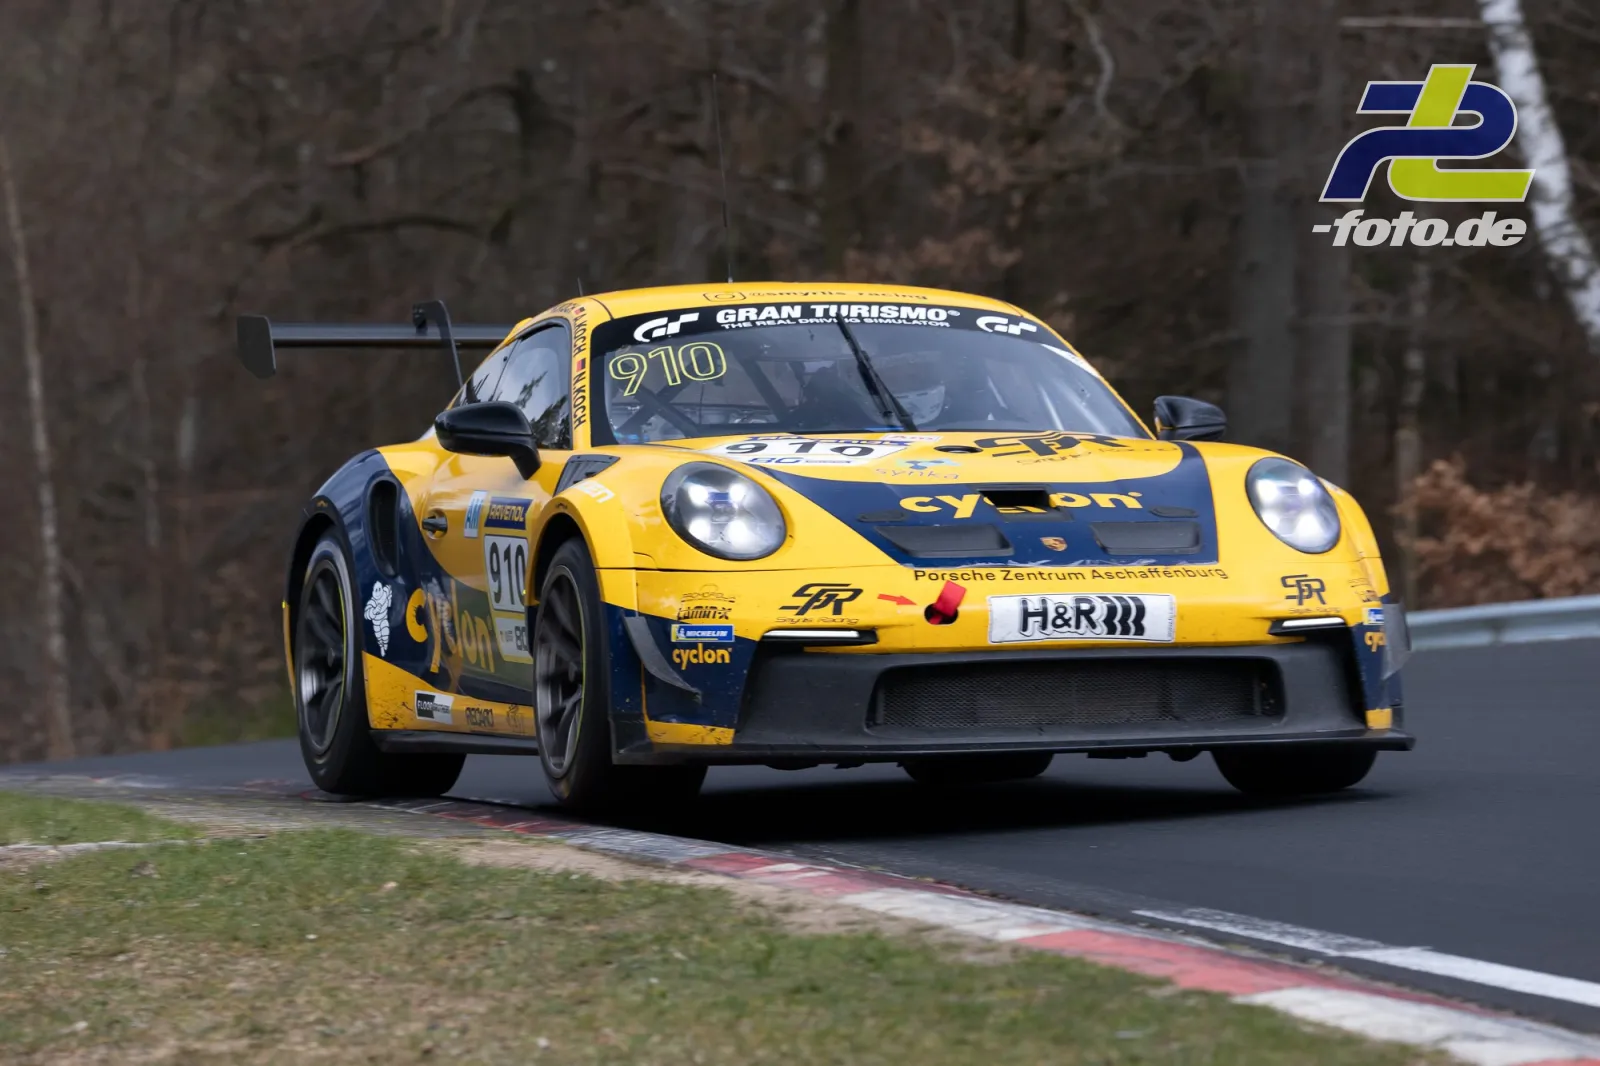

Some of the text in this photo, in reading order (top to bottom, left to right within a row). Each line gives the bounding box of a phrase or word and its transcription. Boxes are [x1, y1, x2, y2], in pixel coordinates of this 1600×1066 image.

[716, 305, 802, 323] GRAN
[721, 322, 754, 330] THE
[756, 318, 797, 327] REAL
[864, 318, 950, 328] SIMULATOR
[609, 341, 727, 396] 910
[573, 370, 587, 430] N.KOCH
[725, 440, 874, 456] 910
[488, 503, 525, 522] RAVENOL
[490, 541, 526, 606] 910
[914, 566, 1229, 581] Porsche Zentrum Aschaffenburg
[1021, 597, 1098, 632] H&R
[672, 643, 731, 670] cyclon
[465, 707, 495, 728] RECARO
